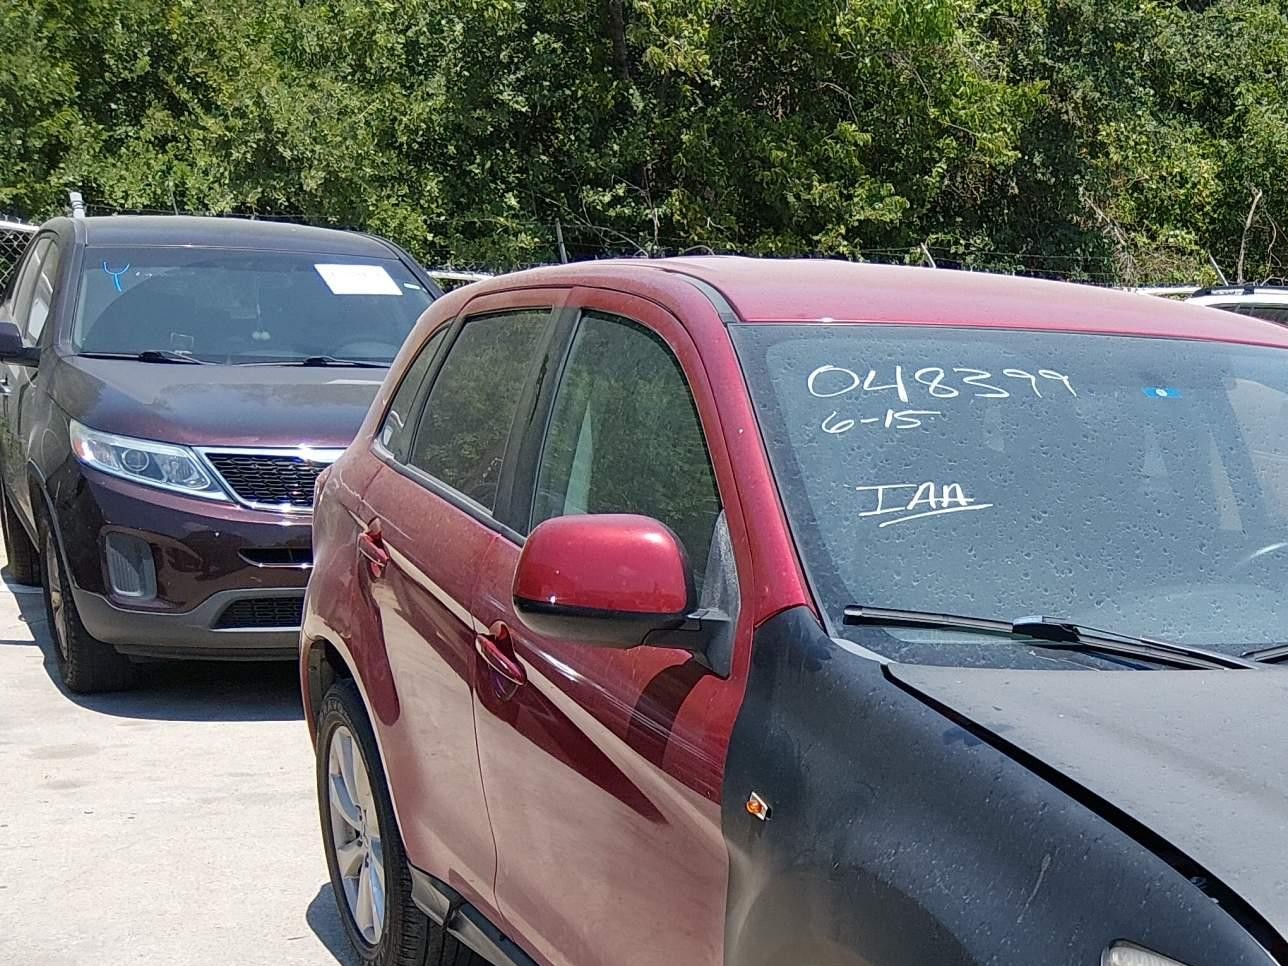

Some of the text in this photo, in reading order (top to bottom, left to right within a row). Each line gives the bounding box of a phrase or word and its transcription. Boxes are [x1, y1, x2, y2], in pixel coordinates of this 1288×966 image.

[807, 364, 1078, 402] 048399
[821, 409, 942, 433] 6-15
[856, 482, 975, 517] IAA
